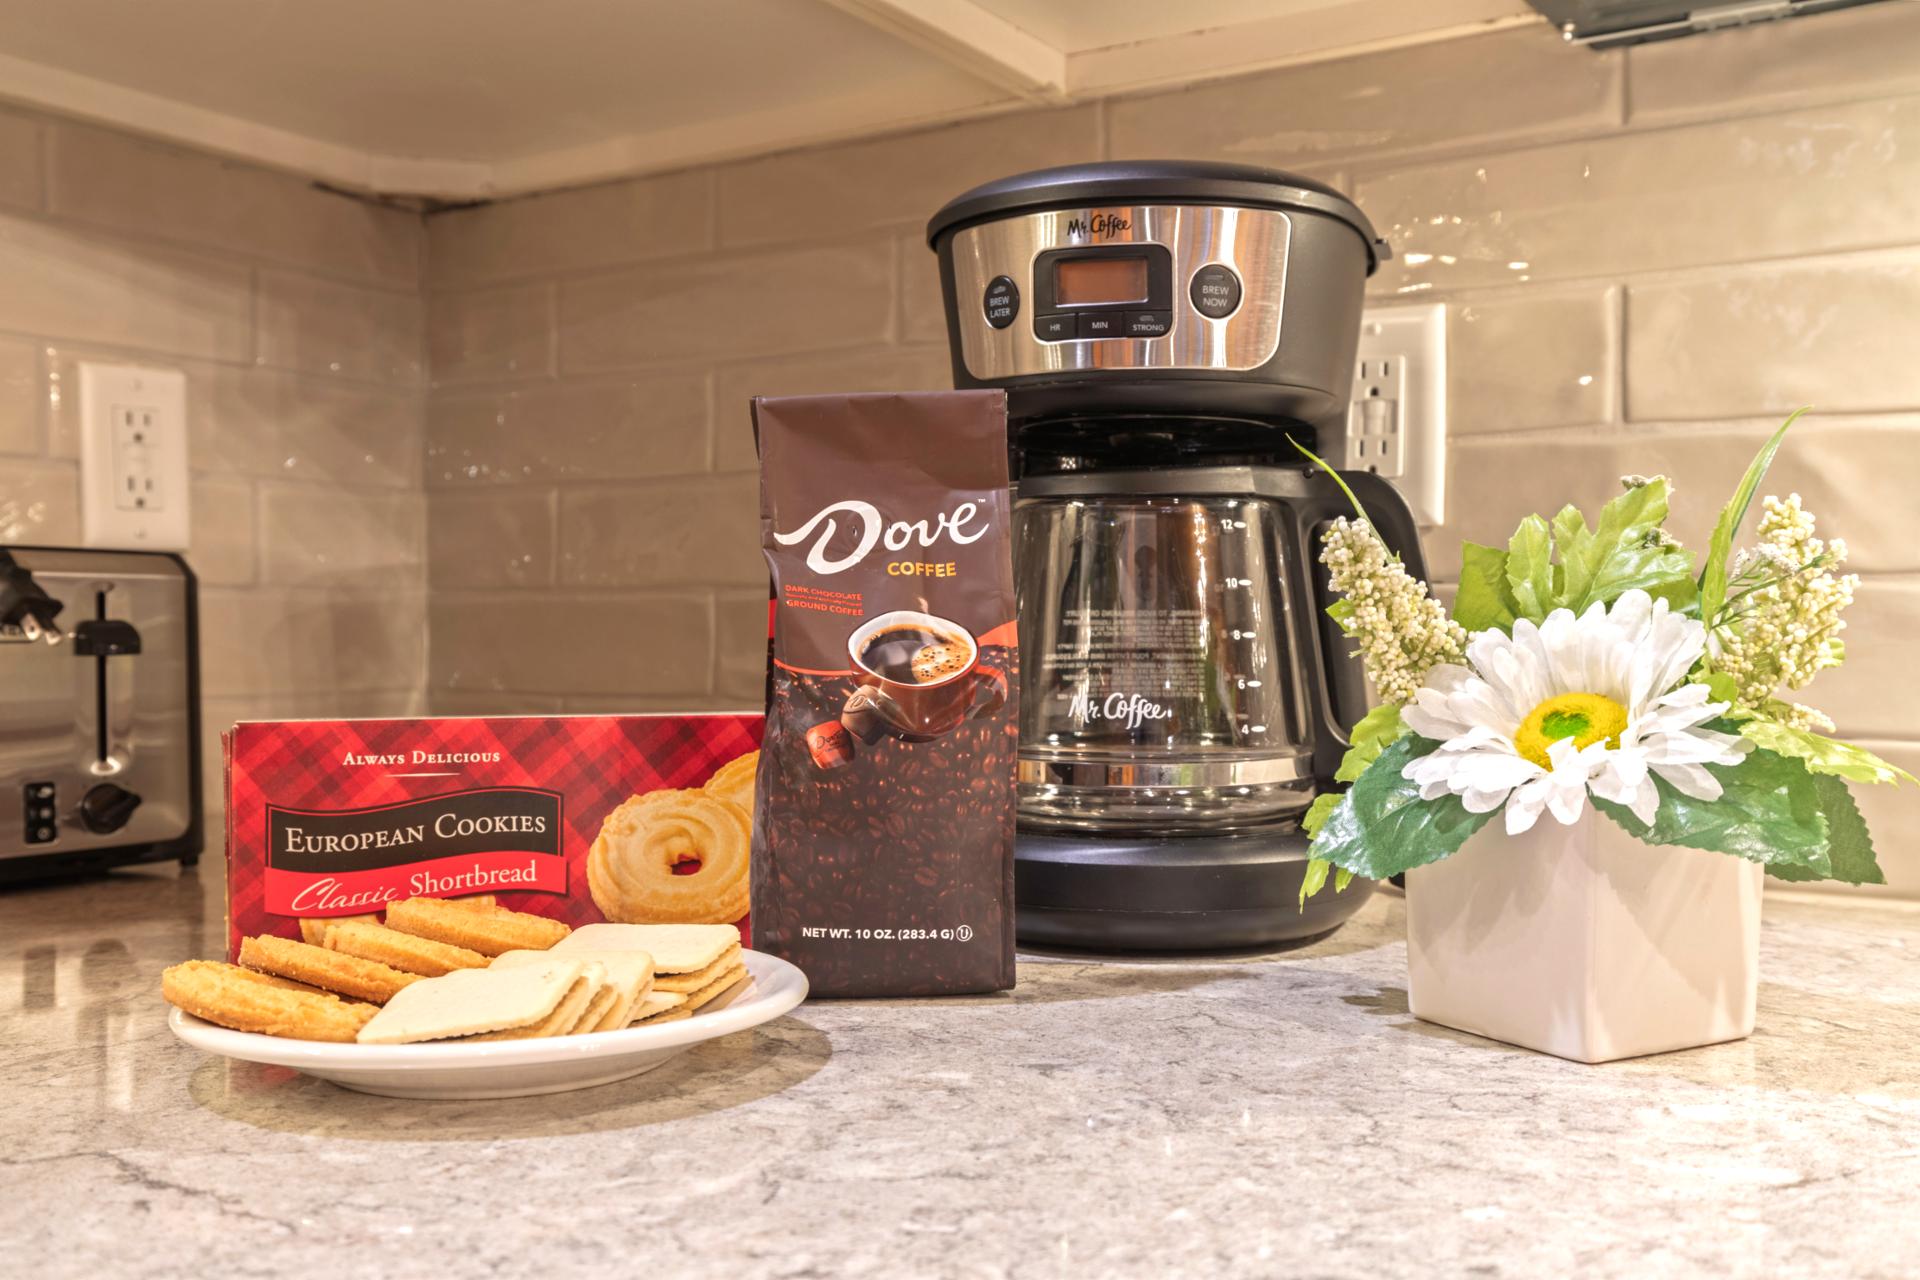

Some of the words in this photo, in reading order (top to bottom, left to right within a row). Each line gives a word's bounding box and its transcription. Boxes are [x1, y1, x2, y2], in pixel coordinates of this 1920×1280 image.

[1067, 218, 1089, 238] Mr.
[1090, 214, 1133, 239] Coffee
[1202, 285, 1230, 295] BREW
[989, 296, 1010, 307] BREW
[1203, 298, 1228, 307] NOW
[989, 308, 1011, 318] LATER
[1050, 324, 1061, 332] HR
[1091, 321, 1109, 329] MIN
[1132, 323, 1165, 332] STRONG
[1221, 519, 1233, 530] 12
[773, 500, 990, 575] Dove
[887, 561, 957, 577] COFFEE
[1225, 577, 1238, 588] 10
[784, 584, 810, 594] DARK
[810, 588, 863, 601] CHOCOLATE
[785, 599, 828, 612] GROUND
[829, 605, 865, 616] COFFEE
[1233, 629, 1241, 640] 8
[1238, 678, 1245, 689] 6
[1068, 693, 1101, 723] Mr.
[1103, 692, 1168, 730] Coffee
[1241, 724, 1249, 735] 4
[291, 877, 400, 911] Classic
[409, 860, 537, 896] Shortbread
[802, 927, 827, 938] NET
[829, 928, 852, 939] WT.
[855, 928, 871, 939] 10
[873, 929, 896, 939] OZ.
[897, 928, 938, 940] (283.4
[940, 928, 955, 940] G)
